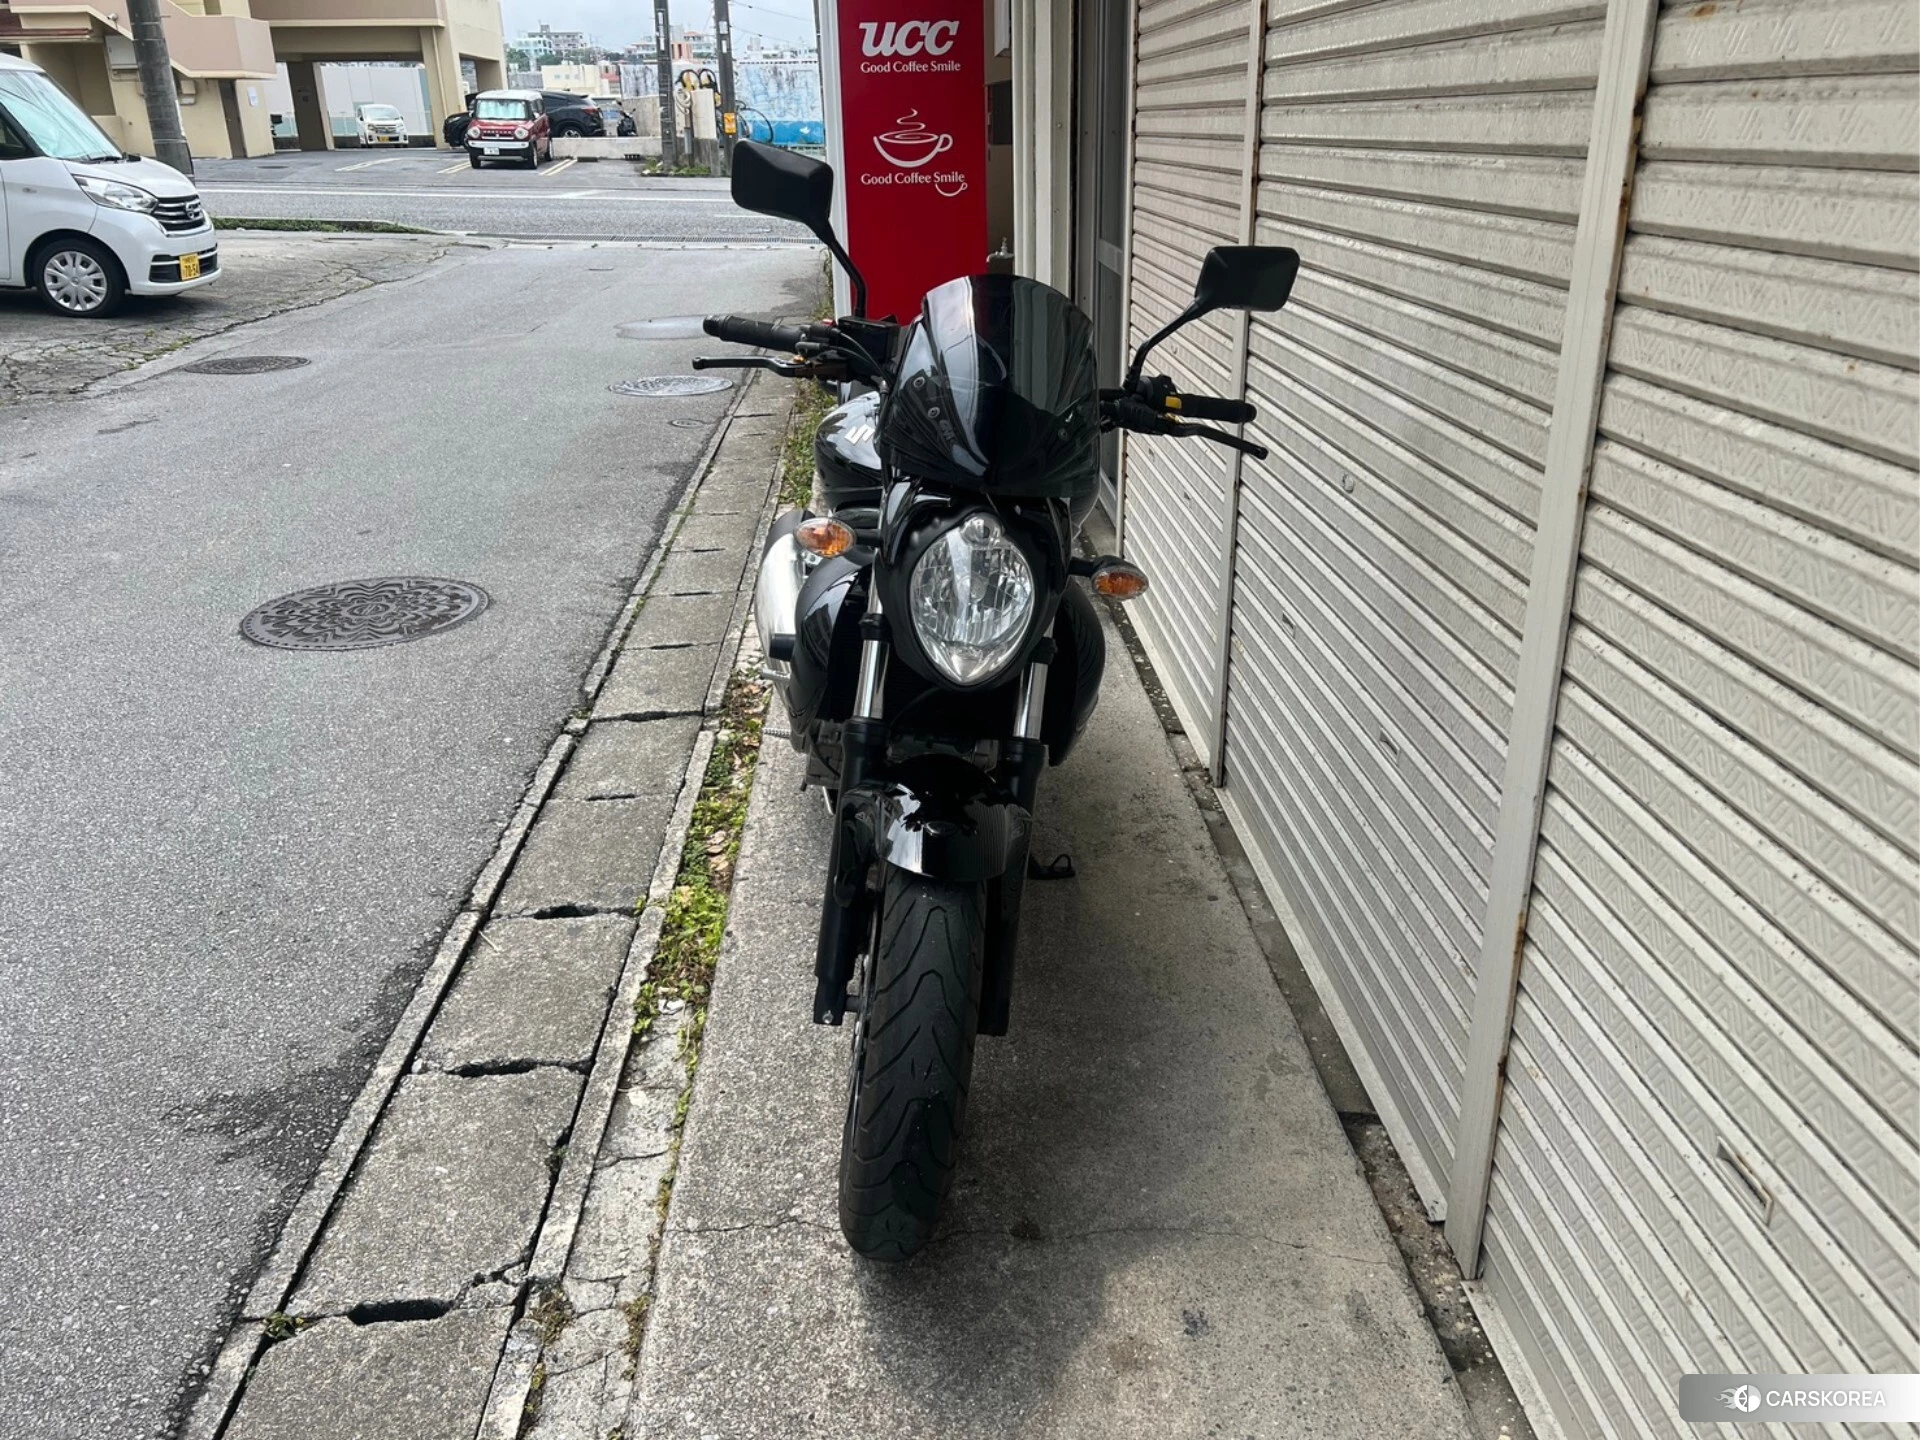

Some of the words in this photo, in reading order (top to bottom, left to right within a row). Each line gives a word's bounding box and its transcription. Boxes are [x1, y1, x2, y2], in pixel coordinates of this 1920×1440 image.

[861, 62, 891, 73] Good
[893, 61, 929, 72] Coffee
[930, 60, 961, 71] Smile
[861, 173, 892, 185] Good
[894, 172, 931, 184] Coffee
[933, 171, 965, 183] Smile
